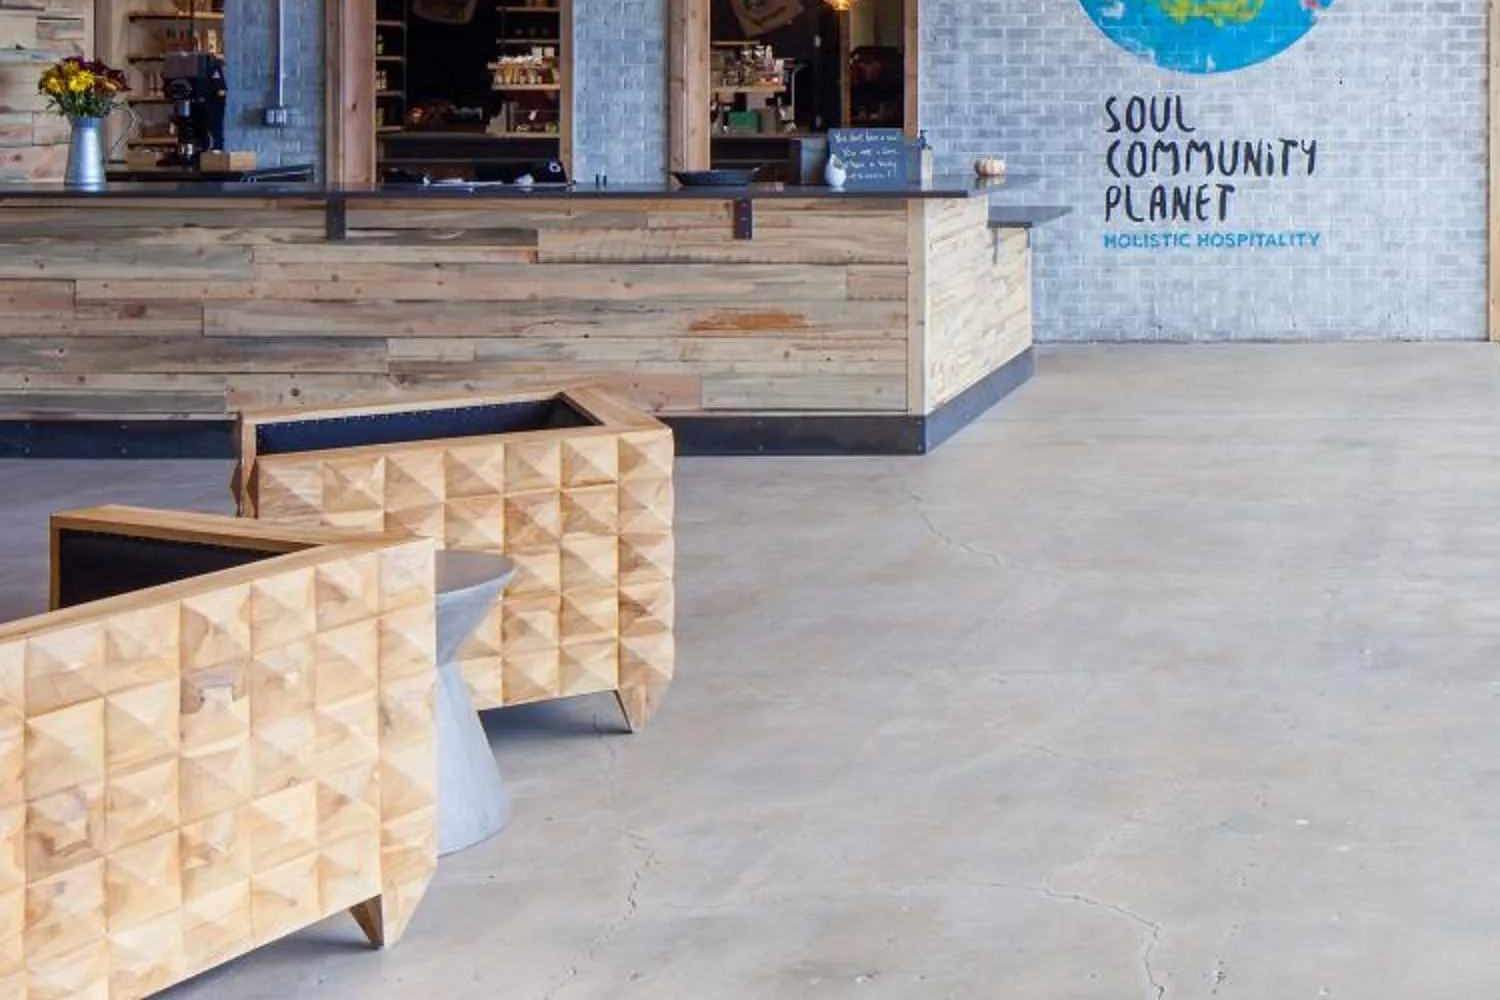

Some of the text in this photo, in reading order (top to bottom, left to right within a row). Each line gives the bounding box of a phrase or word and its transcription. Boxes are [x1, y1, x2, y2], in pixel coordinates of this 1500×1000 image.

[1105, 95, 1195, 133] SOUL
[1105, 183, 1236, 223] PLANET
[1103, 231, 1321, 249] HOLISTIC HOSPITALITY
